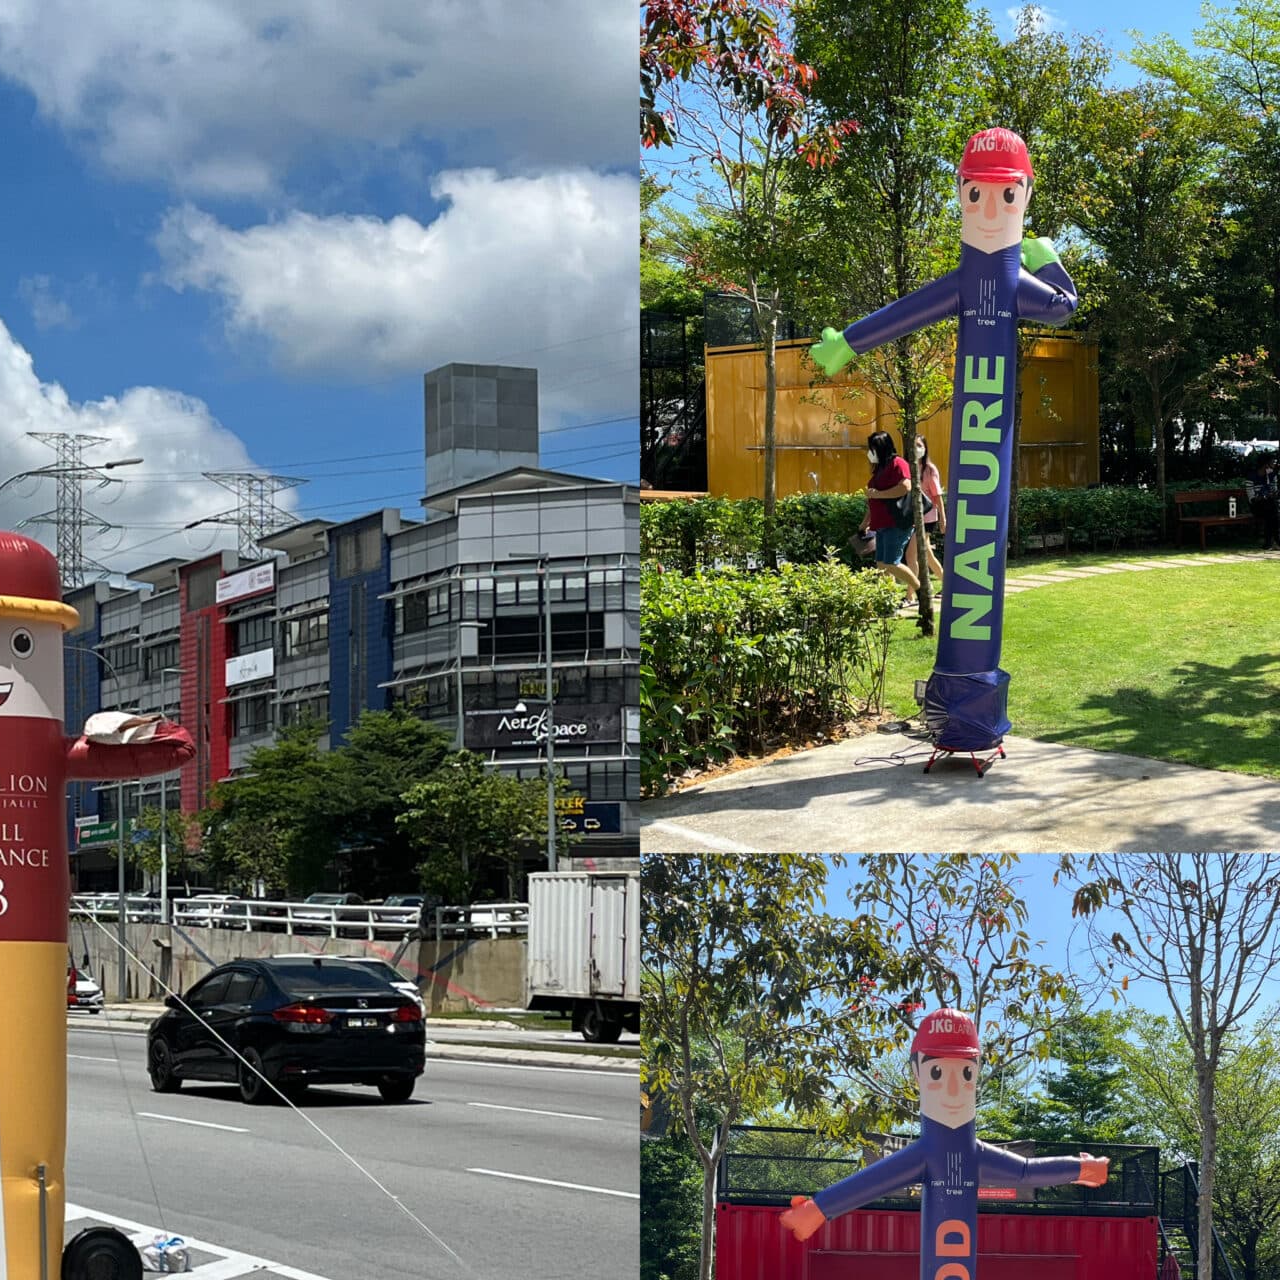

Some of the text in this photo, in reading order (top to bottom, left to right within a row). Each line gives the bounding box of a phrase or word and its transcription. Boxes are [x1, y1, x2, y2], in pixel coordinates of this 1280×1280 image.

[997, 310, 1012, 318] rain
[977, 318, 996, 326] tree
[950, 354, 1005, 642] NATURE
[946, 1188, 963, 1196] tree
